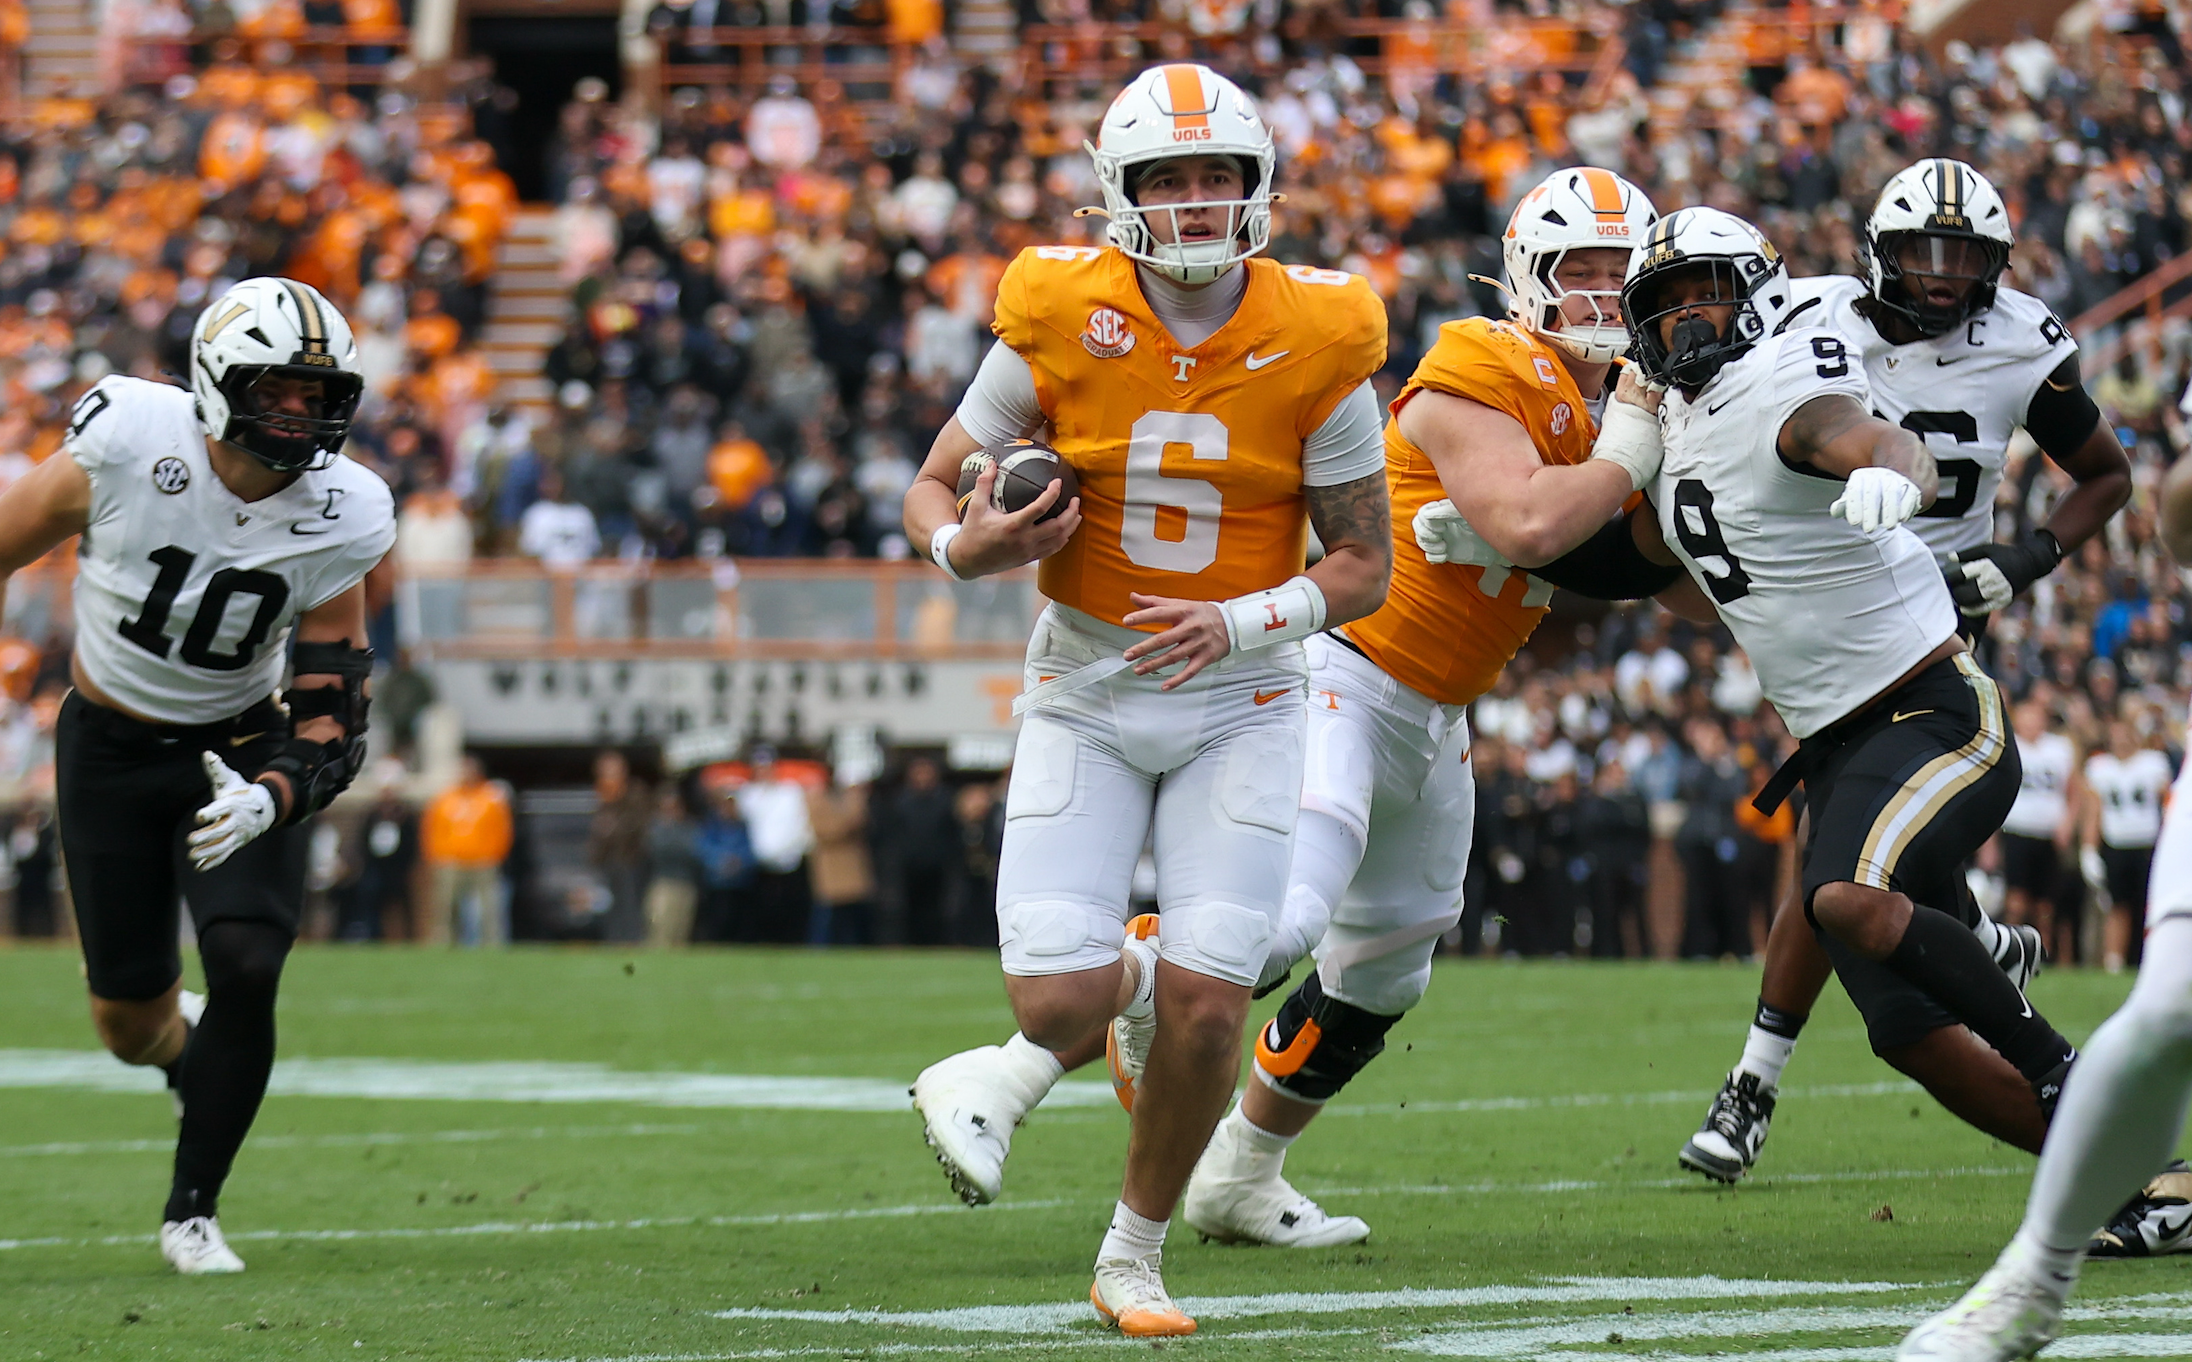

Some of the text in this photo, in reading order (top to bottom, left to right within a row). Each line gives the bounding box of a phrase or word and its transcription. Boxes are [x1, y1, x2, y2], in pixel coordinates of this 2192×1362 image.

[1173, 128, 1212, 142] VOLS
[1597, 225, 1629, 236] VOLS
[1935, 215, 1964, 227] VUFB
[1644, 250, 1675, 268] VUFB
[1089, 308, 1126, 345] SEC
[1967, 320, 1987, 346] C
[304, 353, 333, 367] VUFB
[1085, 341, 1131, 357] GRADUATE
[1810, 337, 1849, 378] 9
[1171, 355, 1197, 382] T
[1532, 356, 1557, 385] C
[1550, 402, 1572, 436] SEC
[154, 458, 190, 494] SEC
[322, 487, 345, 520] C
[1119, 410, 1229, 574] 6
[1674, 479, 1752, 605] 9
[118, 545, 291, 670] 10
[1263, 603, 1287, 632] T
[1319, 691, 1343, 711] T
